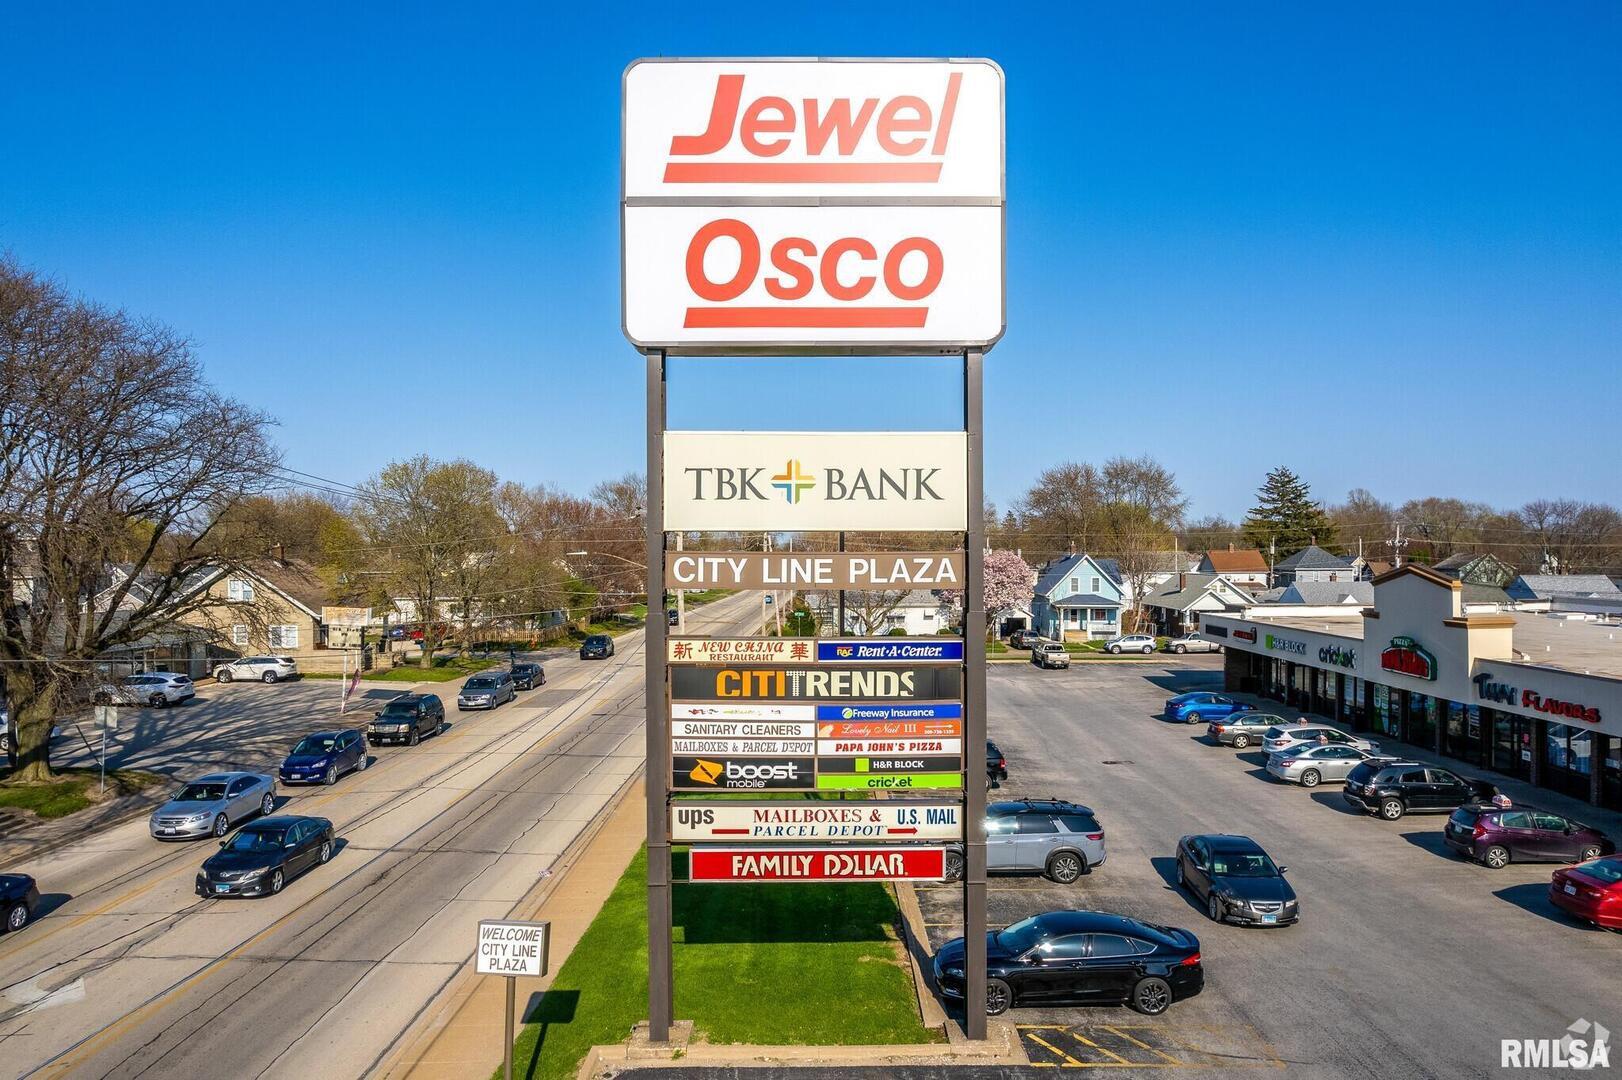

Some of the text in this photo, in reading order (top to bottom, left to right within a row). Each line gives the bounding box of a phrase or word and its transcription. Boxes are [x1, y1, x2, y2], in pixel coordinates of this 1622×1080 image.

[669, 72, 963, 157] Jewel
[685, 218, 944, 302] Osco
[684, 467, 945, 500] TBK BANK
[672, 557, 957, 584] CITY LINE PLAZA
[673, 641, 693, 660] 新
[698, 641, 784, 653] NEW CHINA
[790, 642, 809, 660] 華
[1284, 640, 1305, 655] BLOCK
[709, 653, 775, 661] RESTAURANT
[853, 708, 934, 719] Freeway Insurance
[684, 723, 801, 735] SANITARY CLEANERS
[841, 723, 872, 736] Lovely
[674, 741, 729, 752] MAILBOXES
[731, 743, 738, 752] &
[742, 742, 778, 752] PARCEL
[835, 742, 942, 752] PAPA JOHN'S PIZZA
[726, 761, 798, 779] boost
[873, 760, 924, 769] H&R BLOCK
[678, 809, 715, 829] ups
[753, 808, 882, 823] MAILBOXES &
[897, 808, 957, 825] U.S. MAIL
[753, 825, 884, 836] PARCEL DEPOT
[732, 853, 904, 876] FAMILY DOLLAR
[482, 927, 541, 942] WELCOME
[481, 943, 537, 957] CITY LINE
[489, 958, 527, 971] PLAZA
